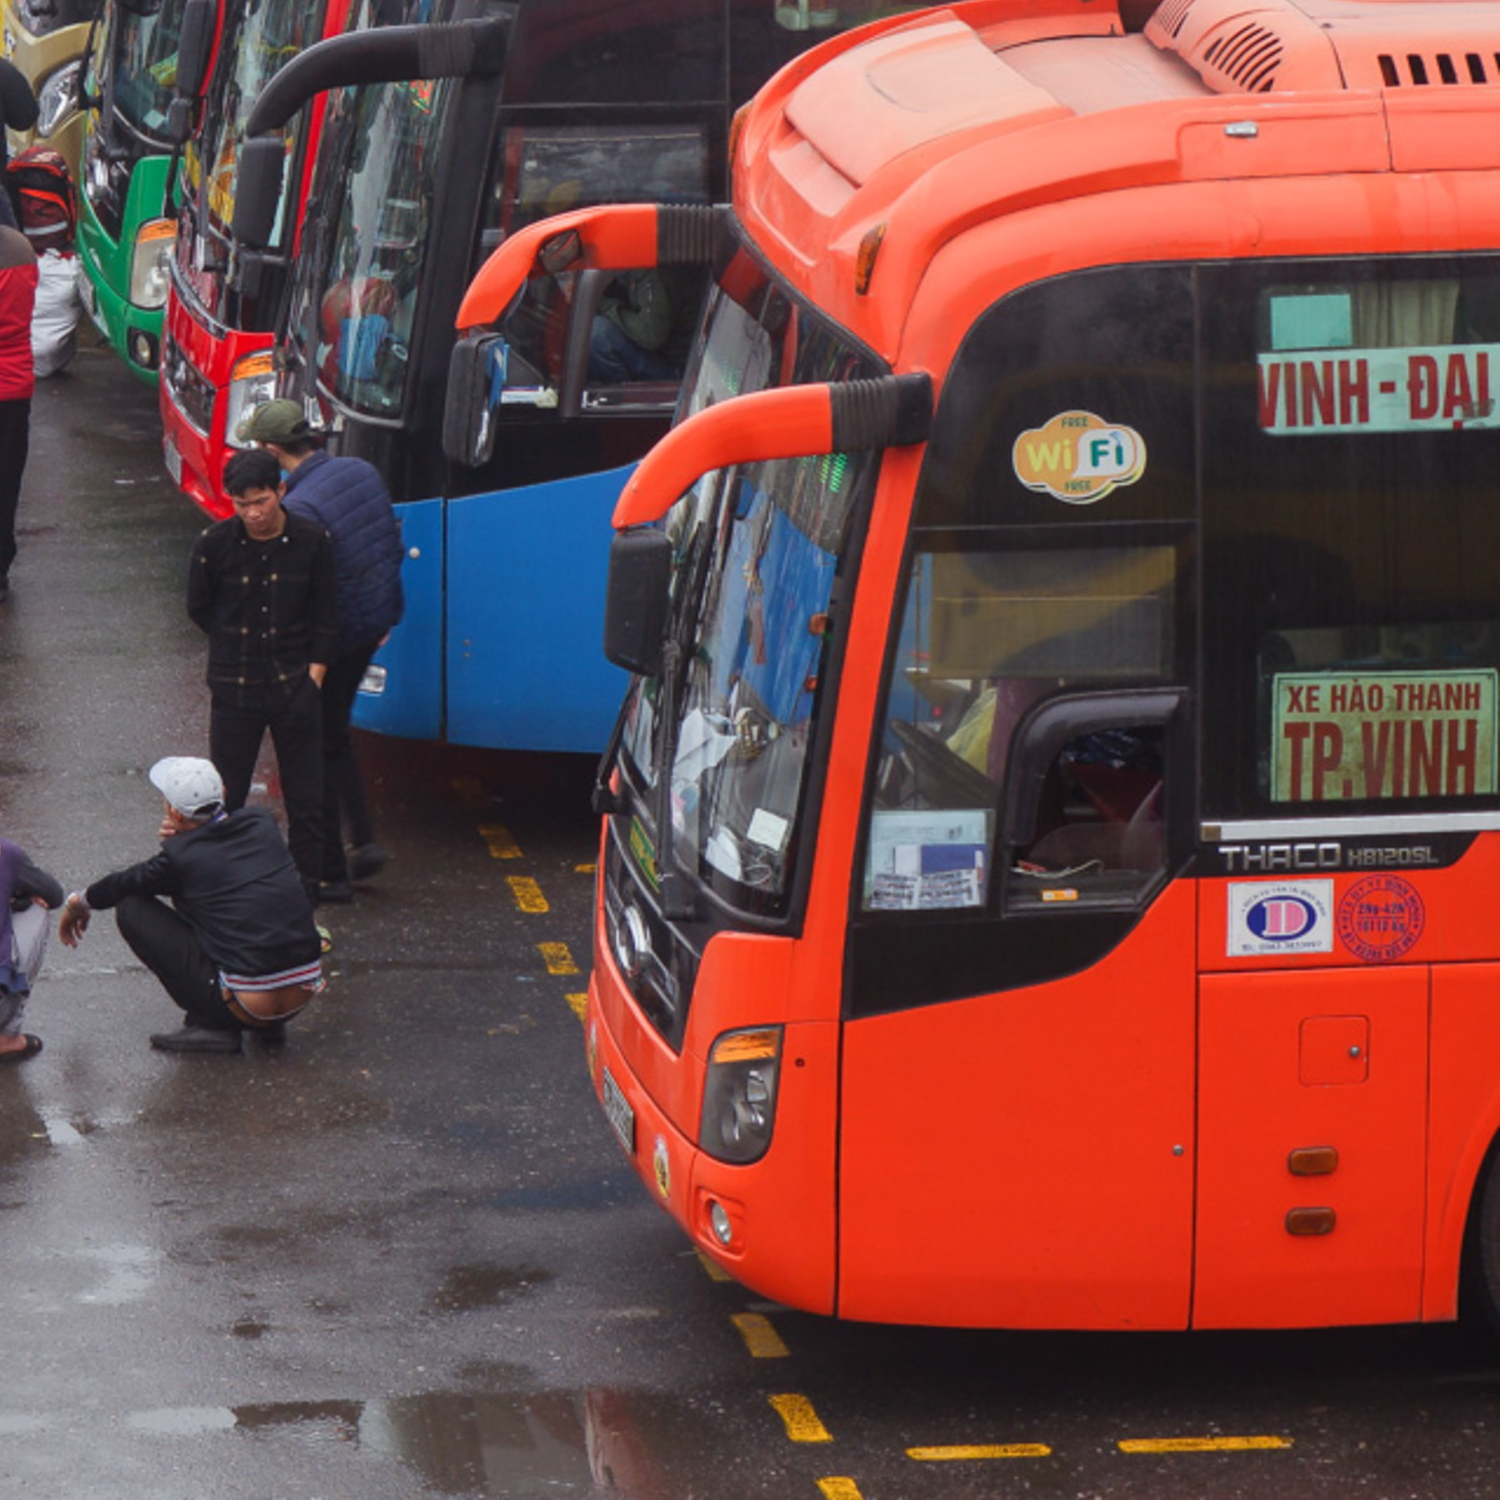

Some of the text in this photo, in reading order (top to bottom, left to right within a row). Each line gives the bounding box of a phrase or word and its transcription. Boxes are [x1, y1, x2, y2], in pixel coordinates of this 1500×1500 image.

[1257, 358, 1369, 429] VINH
[1061, 416, 1088, 428] FREE
[1064, 480, 1091, 492] FREE
[1287, 685, 1320, 713] XE
[1393, 682, 1481, 712] THANH
[1284, 718, 1478, 801] TP.VINH
[1218, 842, 1341, 871] THACO
